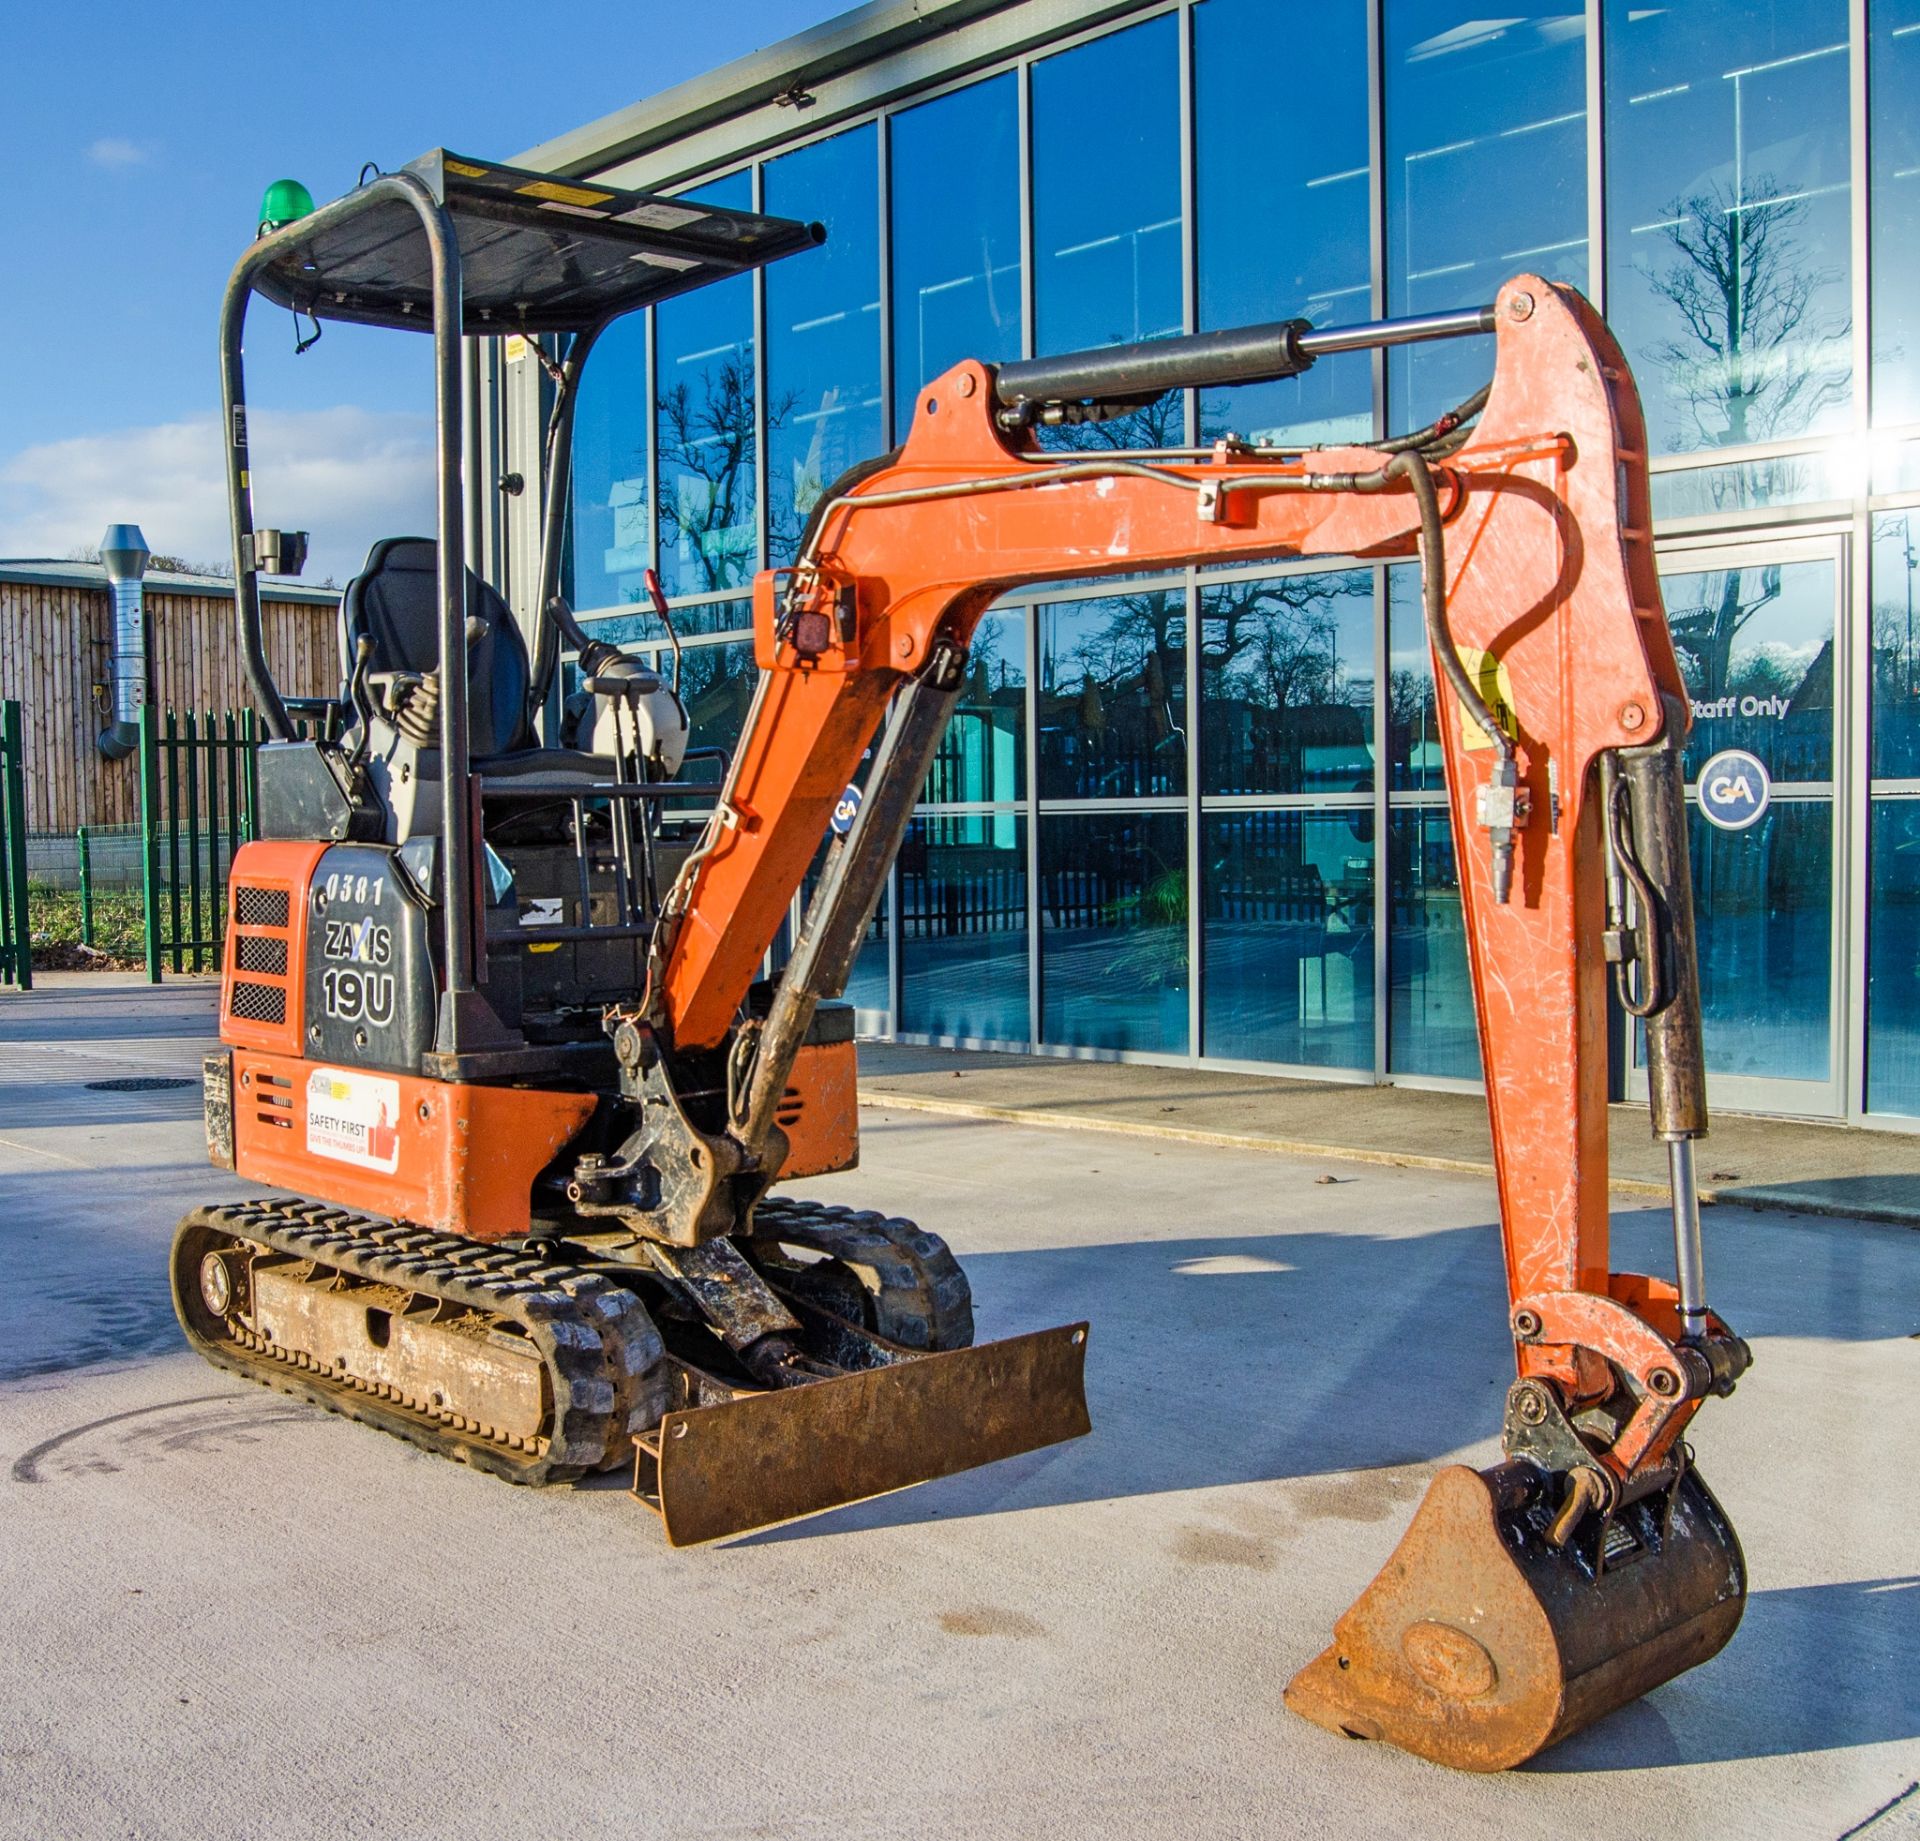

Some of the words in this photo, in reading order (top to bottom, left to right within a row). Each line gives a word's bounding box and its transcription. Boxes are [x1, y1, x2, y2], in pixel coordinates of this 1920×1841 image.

[1740, 695, 1790, 720] Only
[1709, 775, 1755, 804] GA
[326, 873, 384, 906] 0381
[325, 916, 391, 965] ZAXIS
[324, 968, 394, 1027] 19U
[309, 1112, 340, 1131] SAFETY
[341, 1120, 366, 1137] FIRST
